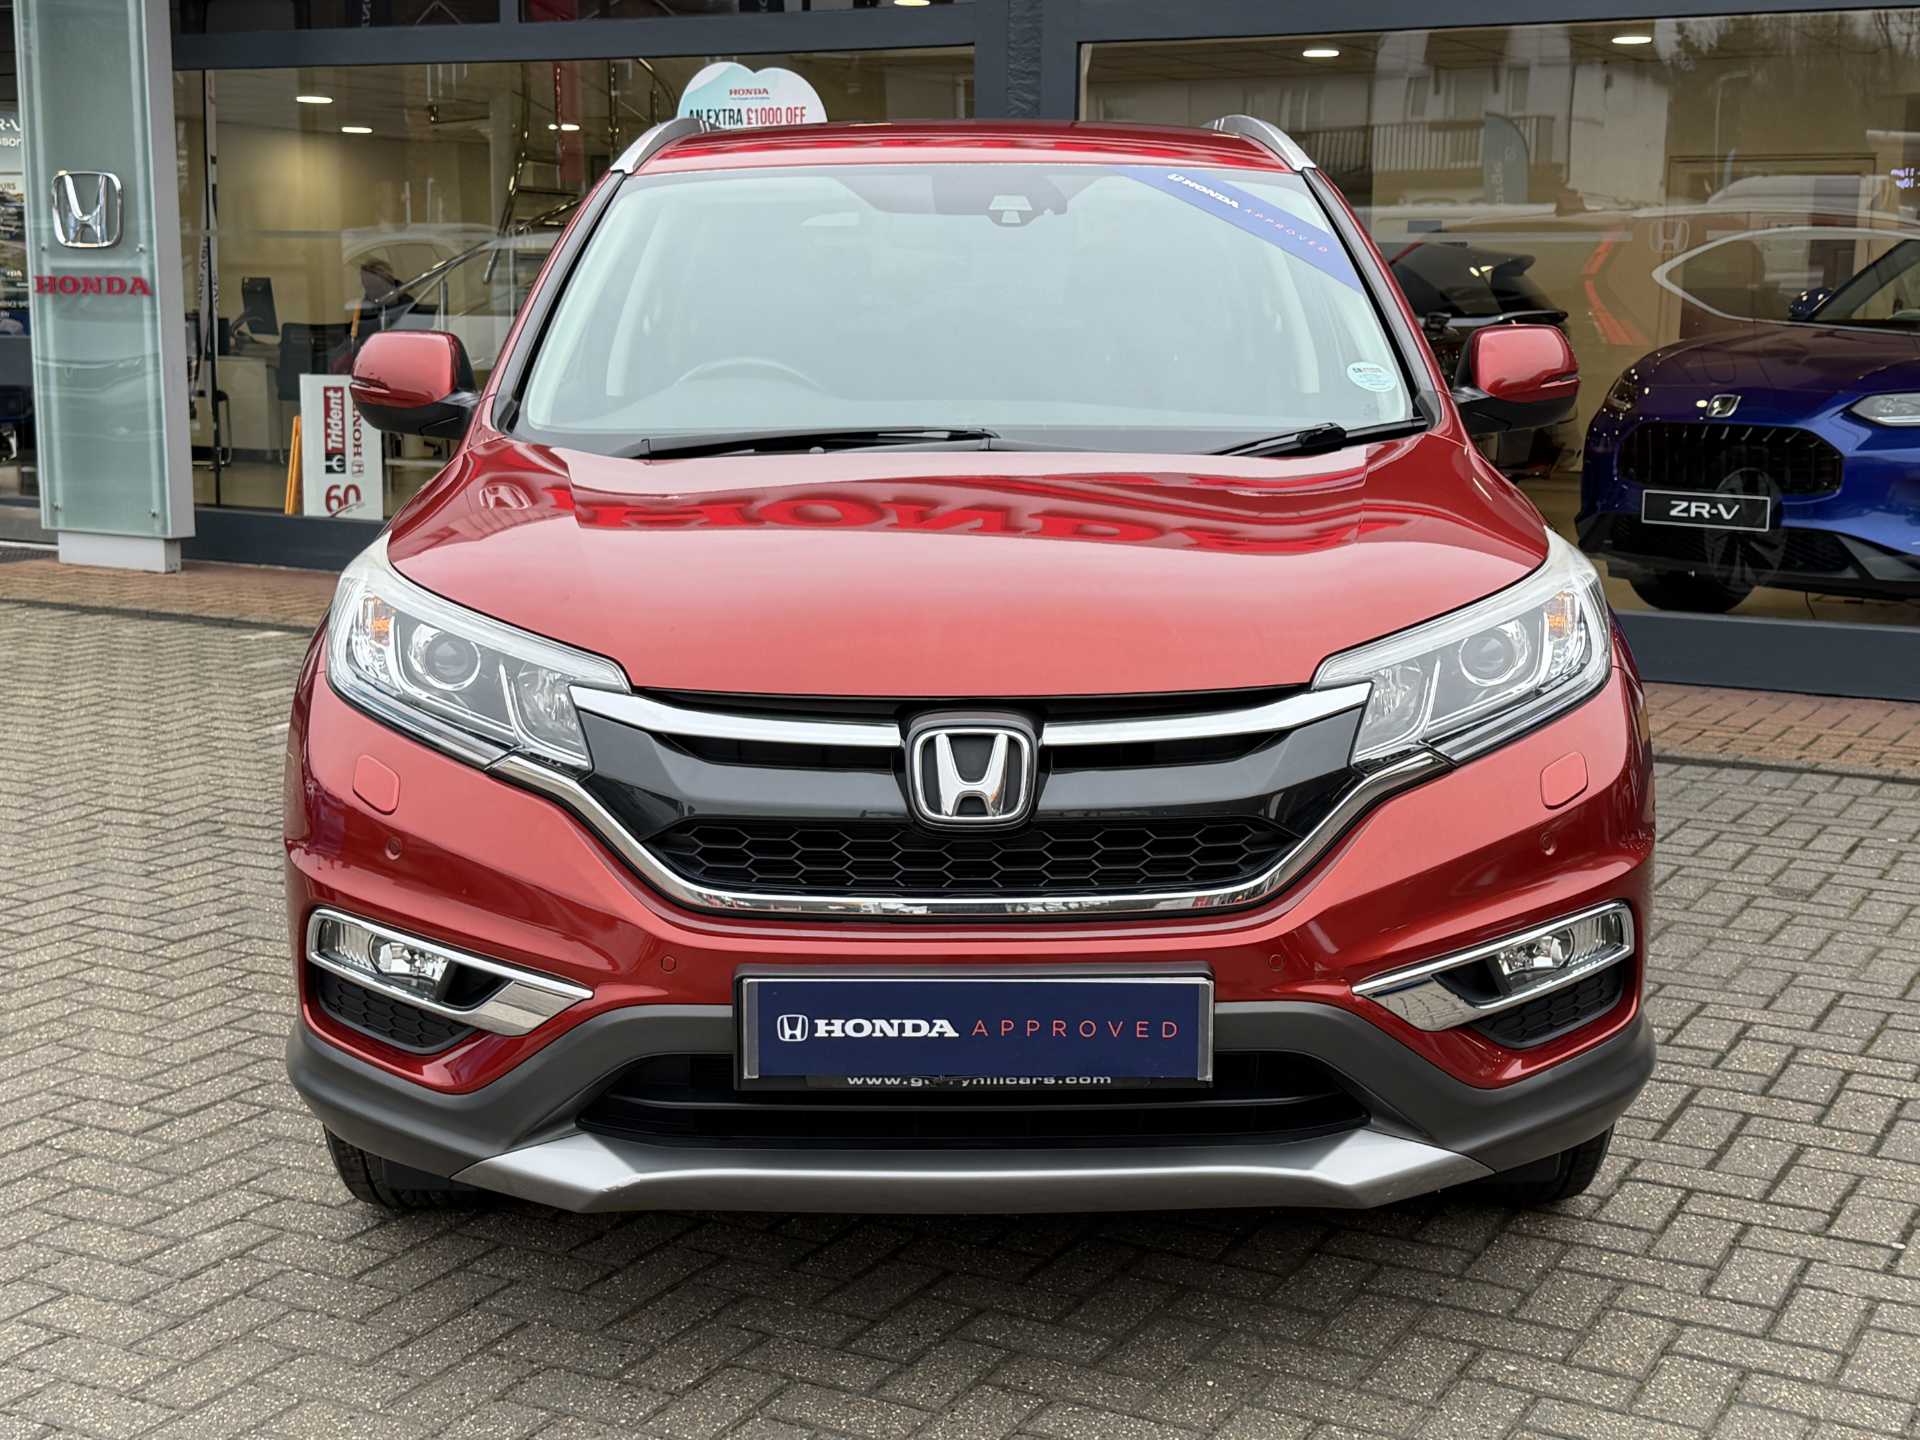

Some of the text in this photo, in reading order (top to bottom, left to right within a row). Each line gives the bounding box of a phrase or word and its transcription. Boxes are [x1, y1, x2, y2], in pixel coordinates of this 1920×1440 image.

[729, 87, 769, 96] HONDA
[689, 106, 806, 125] AN EXTRA £1000 OFF
[1183, 179, 1328, 254] HONDA APPROVED
[34, 275, 152, 296] HONDA
[326, 388, 343, 451] Trident
[353, 402, 362, 457] HON
[1669, 500, 1740, 520] ZR-V
[814, 1018, 1179, 1039] HONDA APPROVED
